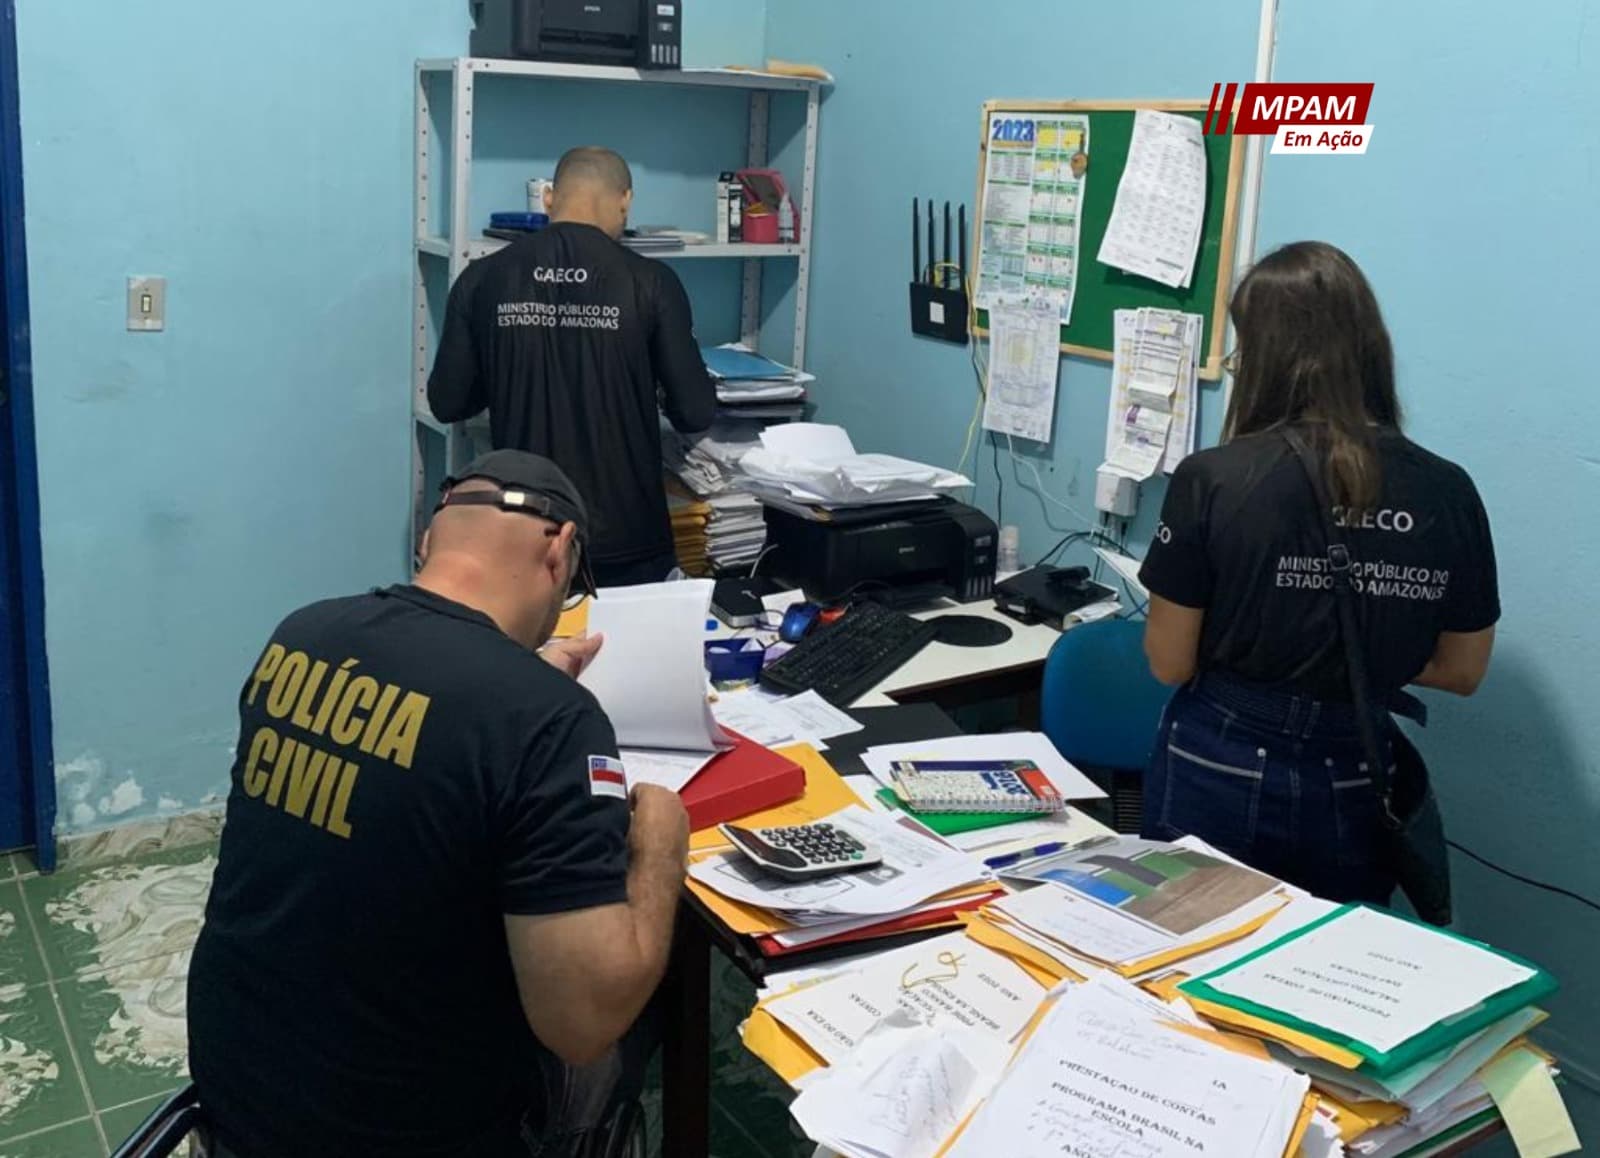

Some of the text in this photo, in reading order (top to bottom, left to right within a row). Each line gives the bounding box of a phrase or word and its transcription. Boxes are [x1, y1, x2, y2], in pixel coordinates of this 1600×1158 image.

[992, 119, 1034, 142] 2023
[533, 266, 588, 283] GAECO
[498, 315, 541, 326] ESTADO
[560, 317, 619, 330] AMAZONAS
[557, 302, 600, 317] PÚBLICO
[602, 305, 620, 318] DO
[1275, 572, 1334, 590] ESTADO
[1364, 559, 1430, 583] PÚBLICO
[1431, 569, 1449, 585] DO
[247, 642, 432, 770] POLÍCIA
[243, 726, 361, 840] CIVIL
[1051, 1080, 1128, 1118] PROGRAMA
[1130, 1112, 1184, 1142] BRASIL
[1184, 1134, 1206, 1153] NA
[1141, 1089, 1160, 1104] DE
[1161, 1097, 1217, 1127] CONTAS
[1090, 1108, 1145, 1138] ESCOLA
